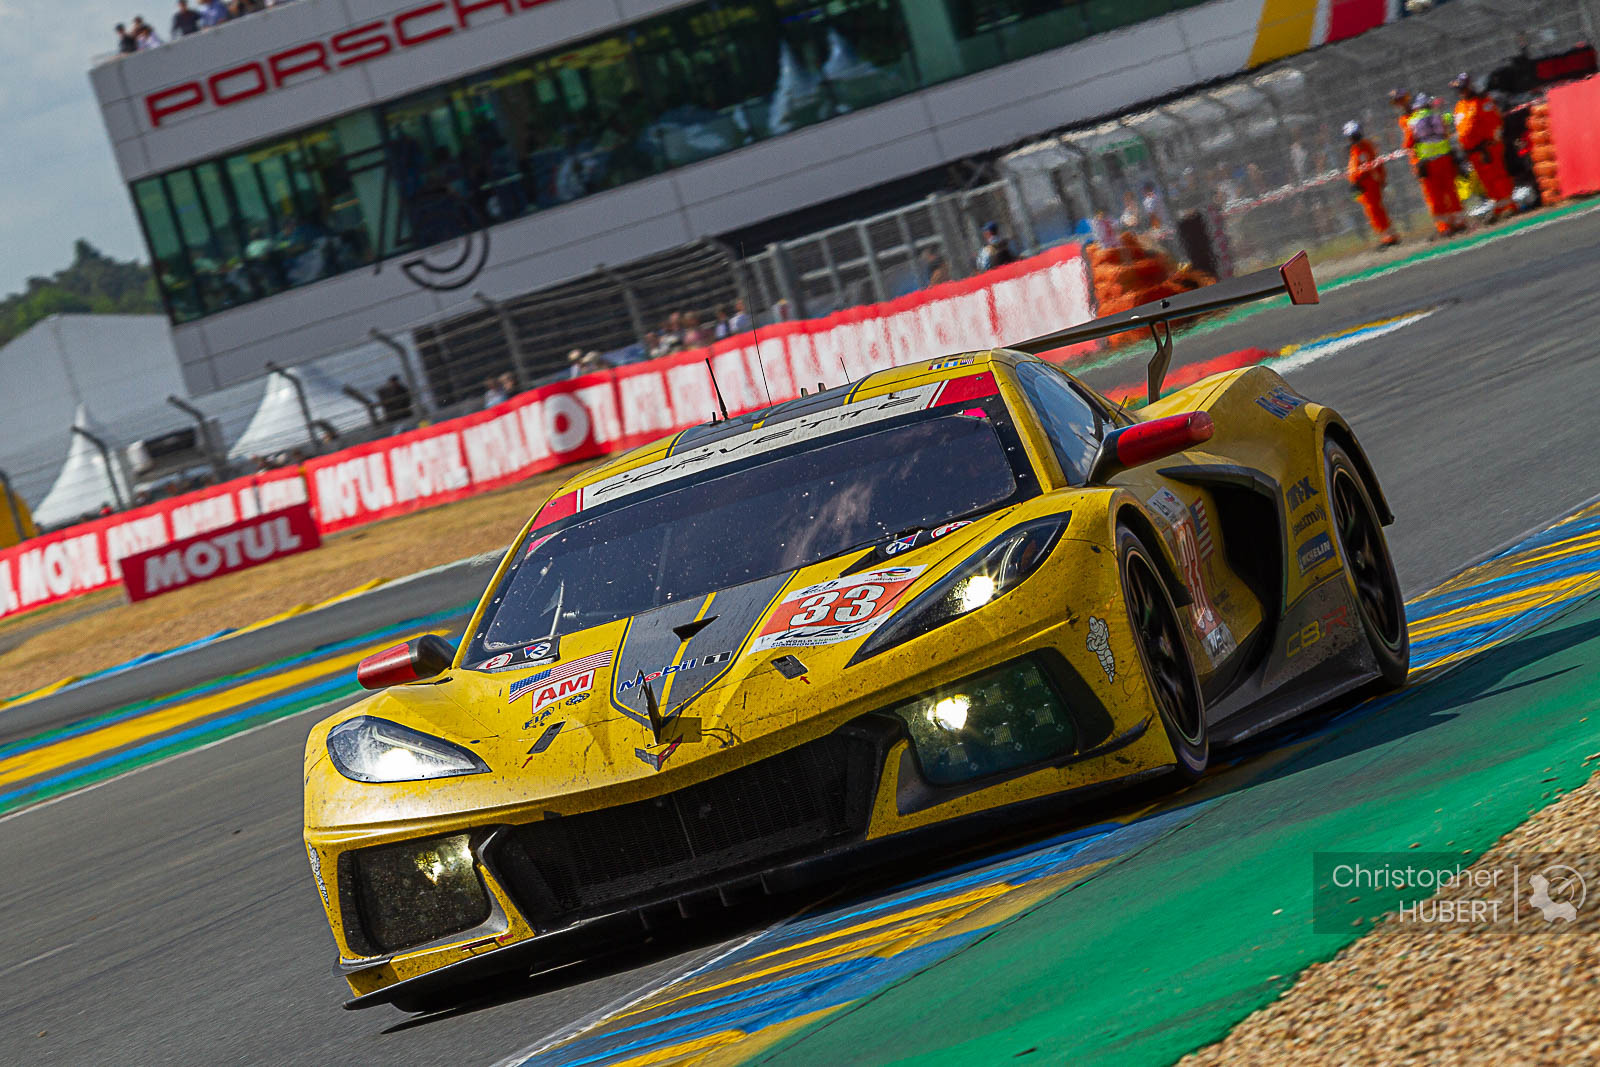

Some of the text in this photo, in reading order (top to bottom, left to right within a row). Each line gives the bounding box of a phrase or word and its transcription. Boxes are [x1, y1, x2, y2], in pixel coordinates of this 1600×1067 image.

[145, 0, 562, 128] PORSCH
[592, 393, 920, 498] CORVETTE
[144, 516, 301, 593] MOTUL
[789, 583, 886, 626] 33
[776, 620, 869, 641] WEC
[535, 674, 590, 709] AM
[618, 658, 698, 693] Mobil
[524, 708, 553, 728] FIA
